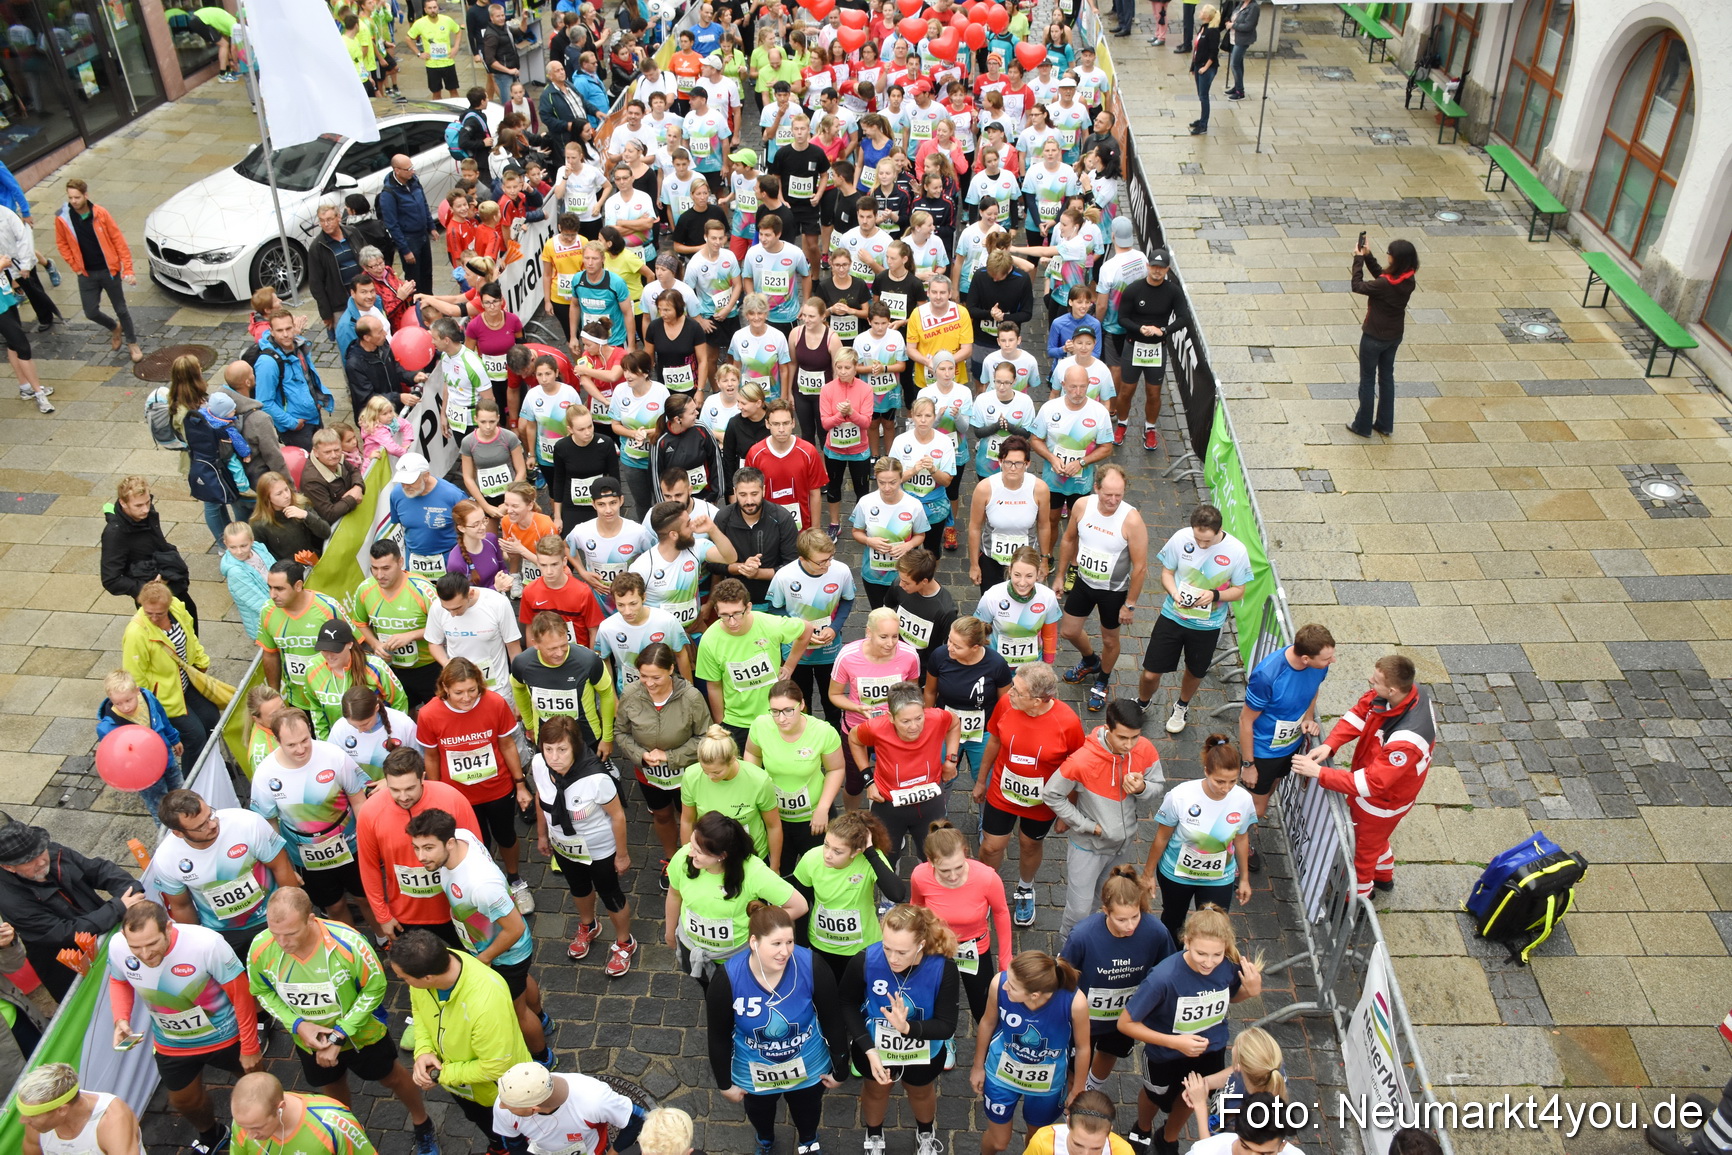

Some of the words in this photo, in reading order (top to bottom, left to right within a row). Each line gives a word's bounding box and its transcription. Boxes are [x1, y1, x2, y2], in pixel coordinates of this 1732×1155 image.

[431, 46, 446, 54] 2905
[678, 80, 694, 88] 5322
[913, 125, 930, 133] 5225
[791, 182, 812, 191] 5019
[568, 198, 586, 206] 5007
[1041, 207, 1060, 215] 5009
[853, 264, 874, 276] 5232
[764, 277, 787, 287] 5231
[833, 321, 857, 333] 5253
[924, 332, 942, 341] MAX
[1136, 349, 1159, 358] 5184
[666, 372, 691, 384] 5324
[800, 376, 822, 389] 5193
[870, 375, 895, 386] 5164
[833, 427, 858, 441] 5135
[481, 472, 510, 487] 5045
[412, 559, 442, 574] 5014
[1080, 555, 1108, 573] 5015
[898, 615, 927, 639] 5191
[1002, 643, 1033, 656] 5171
[733, 661, 769, 681] 5194
[537, 697, 574, 710] 5156
[454, 754, 491, 772] 5047
[1004, 780, 1039, 797] 5084
[898, 788, 937, 805] 5085
[305, 843, 344, 862] 5064
[1183, 853, 1221, 873] 5248
[401, 872, 440, 886] 5116
[213, 881, 254, 912] 5081
[690, 918, 729, 939] 5119
[818, 916, 856, 932] 5068
[1112, 958, 1130, 966] Titel
[1097, 965, 1143, 975] Verteidiger
[873, 980, 888, 995] 8
[733, 997, 762, 1017] 45
[1182, 1001, 1224, 1021] 5319
[160, 1015, 201, 1030] 5317
[999, 1007, 1021, 1027] 10
[766, 1049, 795, 1057] BASKETS
[757, 1067, 800, 1082] 5011
[1004, 1062, 1048, 1081] 5138
[984, 1095, 1005, 1116] 10
[322, 1110, 367, 1150] BOCK
